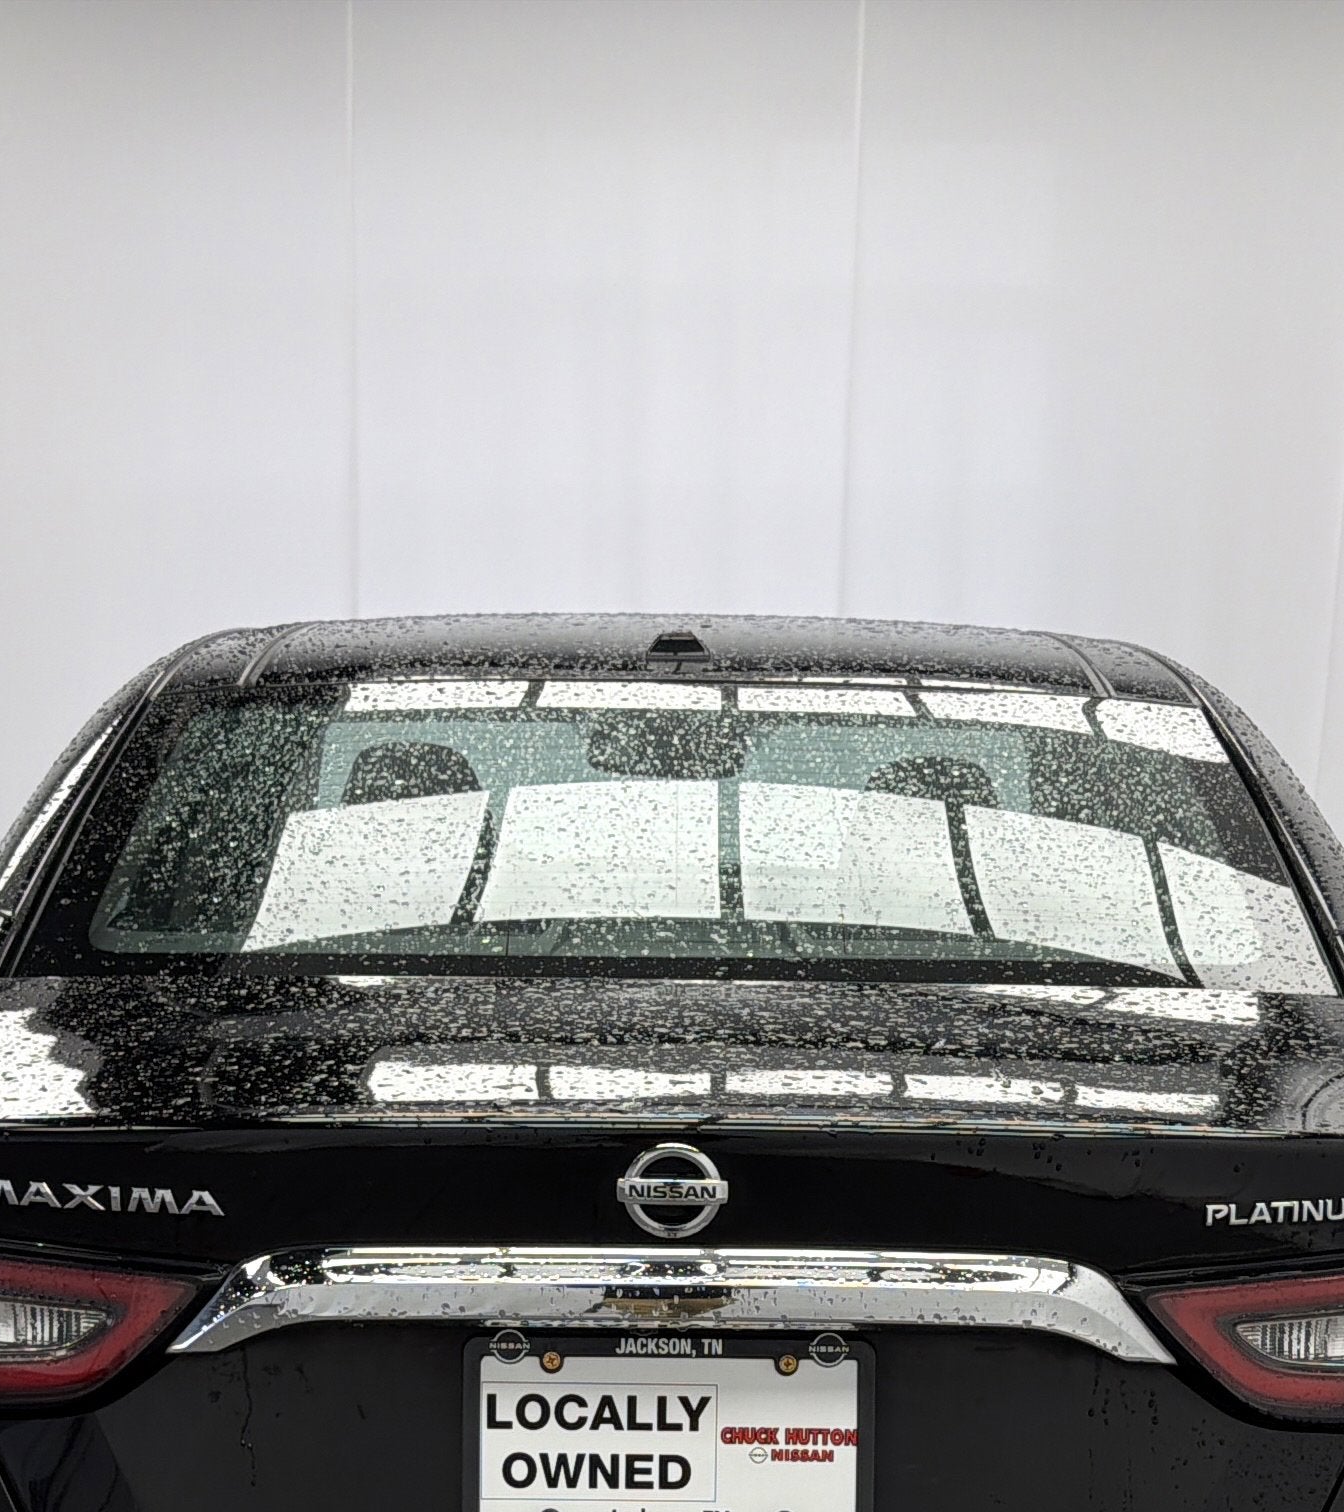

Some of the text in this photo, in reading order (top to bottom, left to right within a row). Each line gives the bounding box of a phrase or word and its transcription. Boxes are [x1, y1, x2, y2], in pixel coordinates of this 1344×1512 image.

[628, 1184, 716, 1199] NISSAN
[489, 1342, 531, 1350] NISSAN
[615, 1337, 723, 1357] JACKSON, TN
[808, 1345, 850, 1353] NISSAN
[486, 1393, 712, 1432] LOCALLY
[720, 1427, 858, 1446] CHUCK HUTTON
[770, 1449, 834, 1462] NISSAN
[502, 1452, 692, 1490] OWNED
